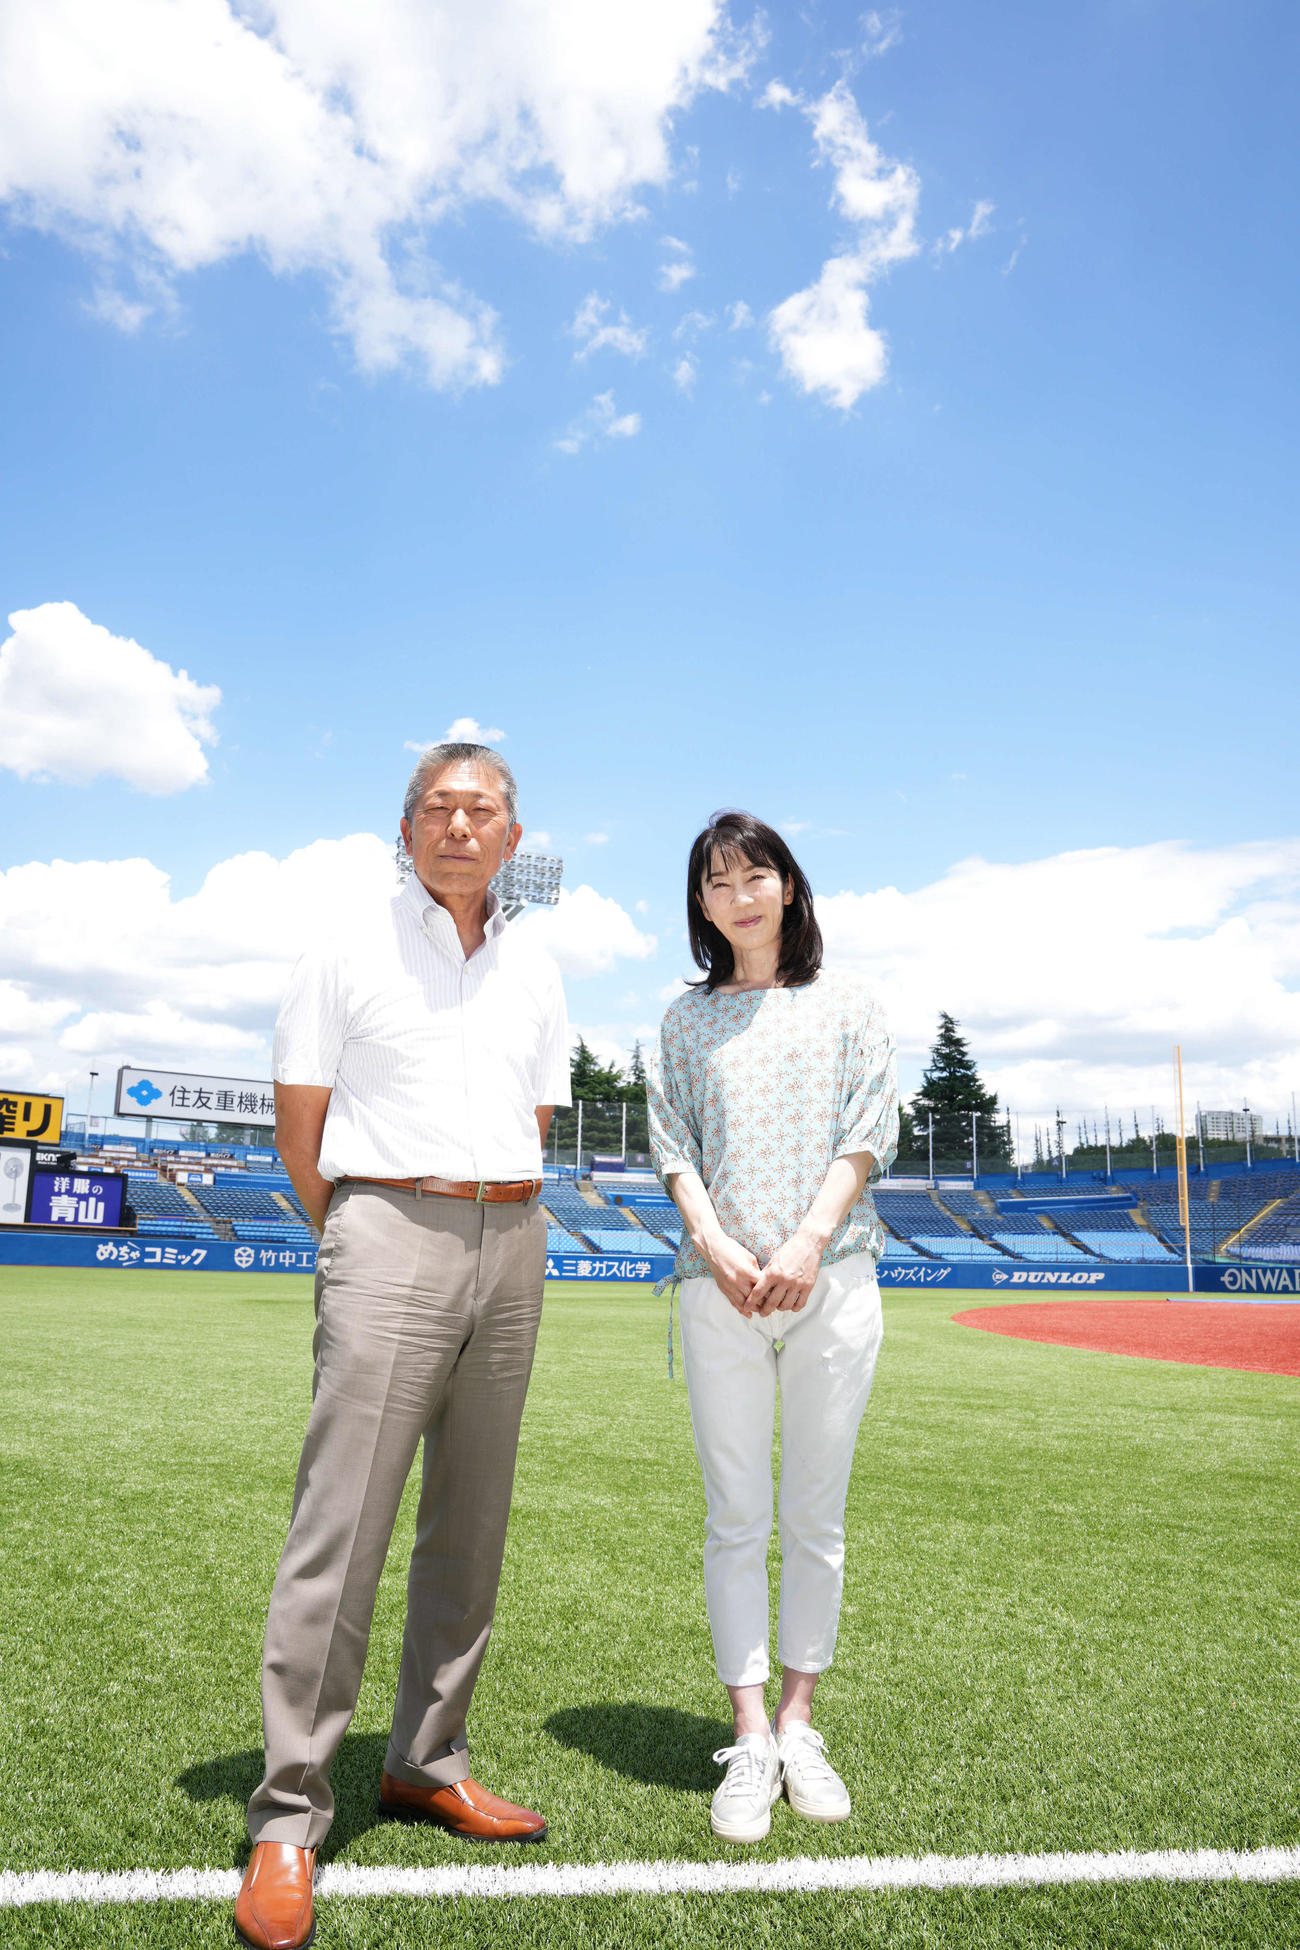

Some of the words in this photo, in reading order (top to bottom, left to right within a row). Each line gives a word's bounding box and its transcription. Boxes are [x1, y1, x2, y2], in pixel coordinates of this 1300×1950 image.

[169, 1085, 275, 1116] 住友重機械
[53, 1176, 103, 1195] 洋服の
[49, 1194, 105, 1223] 青山
[96, 1241, 207, 1266] めちゃコミック
[259, 1250, 317, 1267] 竹中工
[562, 1260, 651, 1278] 三菱ガス化学
[1010, 1271, 1105, 1284] DUNLOP
